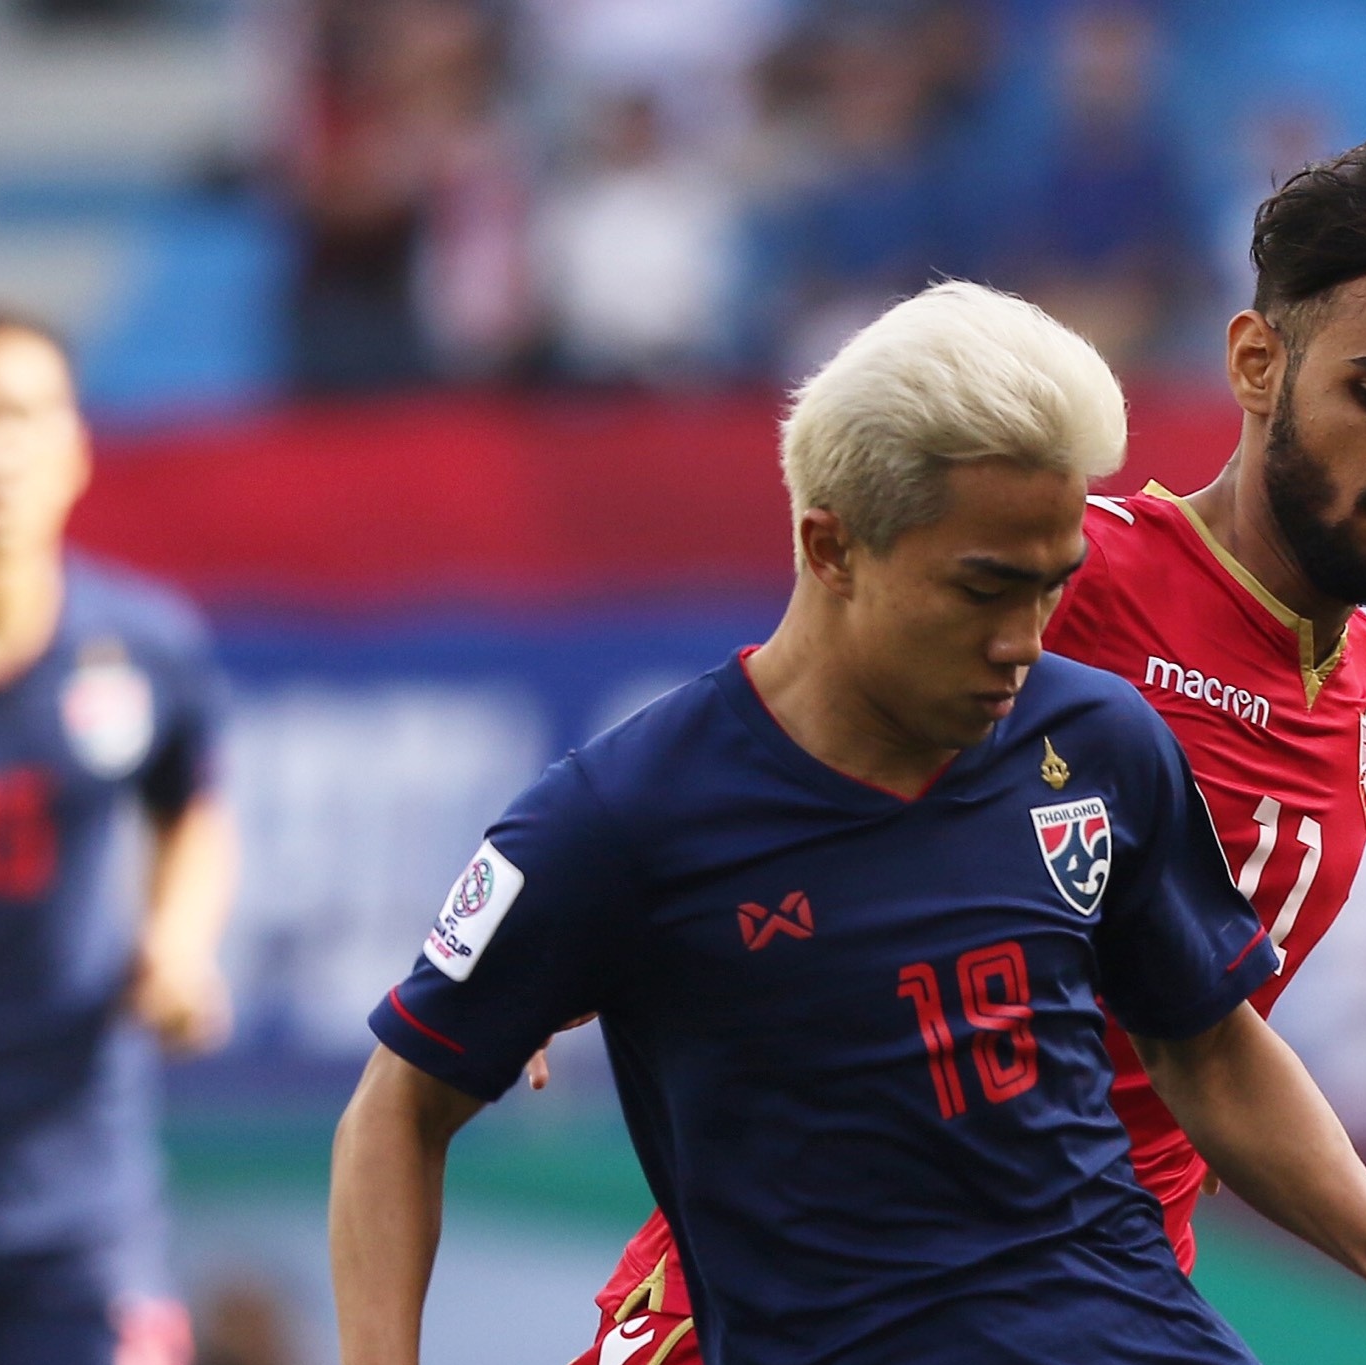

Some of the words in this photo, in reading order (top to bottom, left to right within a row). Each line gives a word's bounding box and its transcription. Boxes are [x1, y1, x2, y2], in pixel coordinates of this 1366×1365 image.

[1145, 656, 1270, 729] macron
[1035, 803, 1102, 826] THAILAND
[1237, 795, 1323, 977] 11
[896, 940, 1039, 1120] 18
